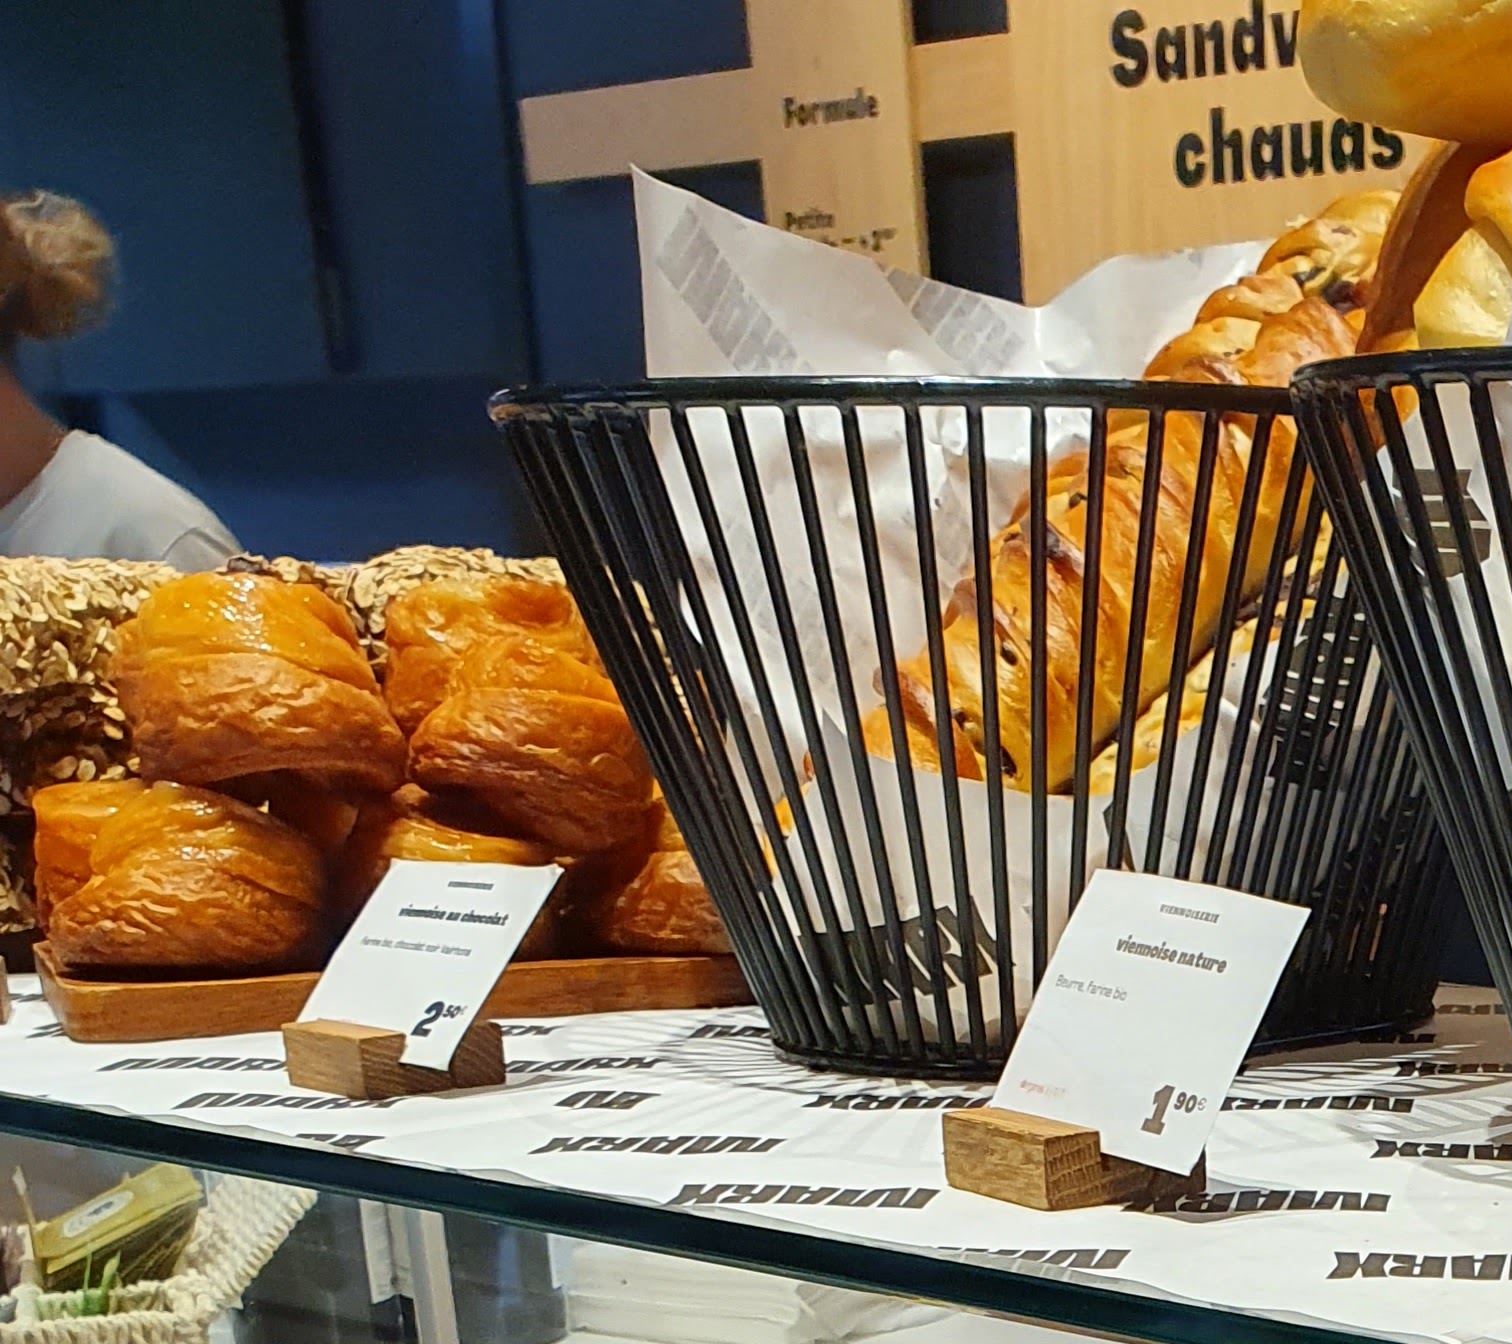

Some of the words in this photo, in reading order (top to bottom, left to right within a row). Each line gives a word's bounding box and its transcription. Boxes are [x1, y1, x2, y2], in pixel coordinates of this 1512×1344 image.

[1116, 935, 1178, 964] viennoise
[1177, 951, 1228, 974] nature
[1112, 984, 1128, 1001] bio
